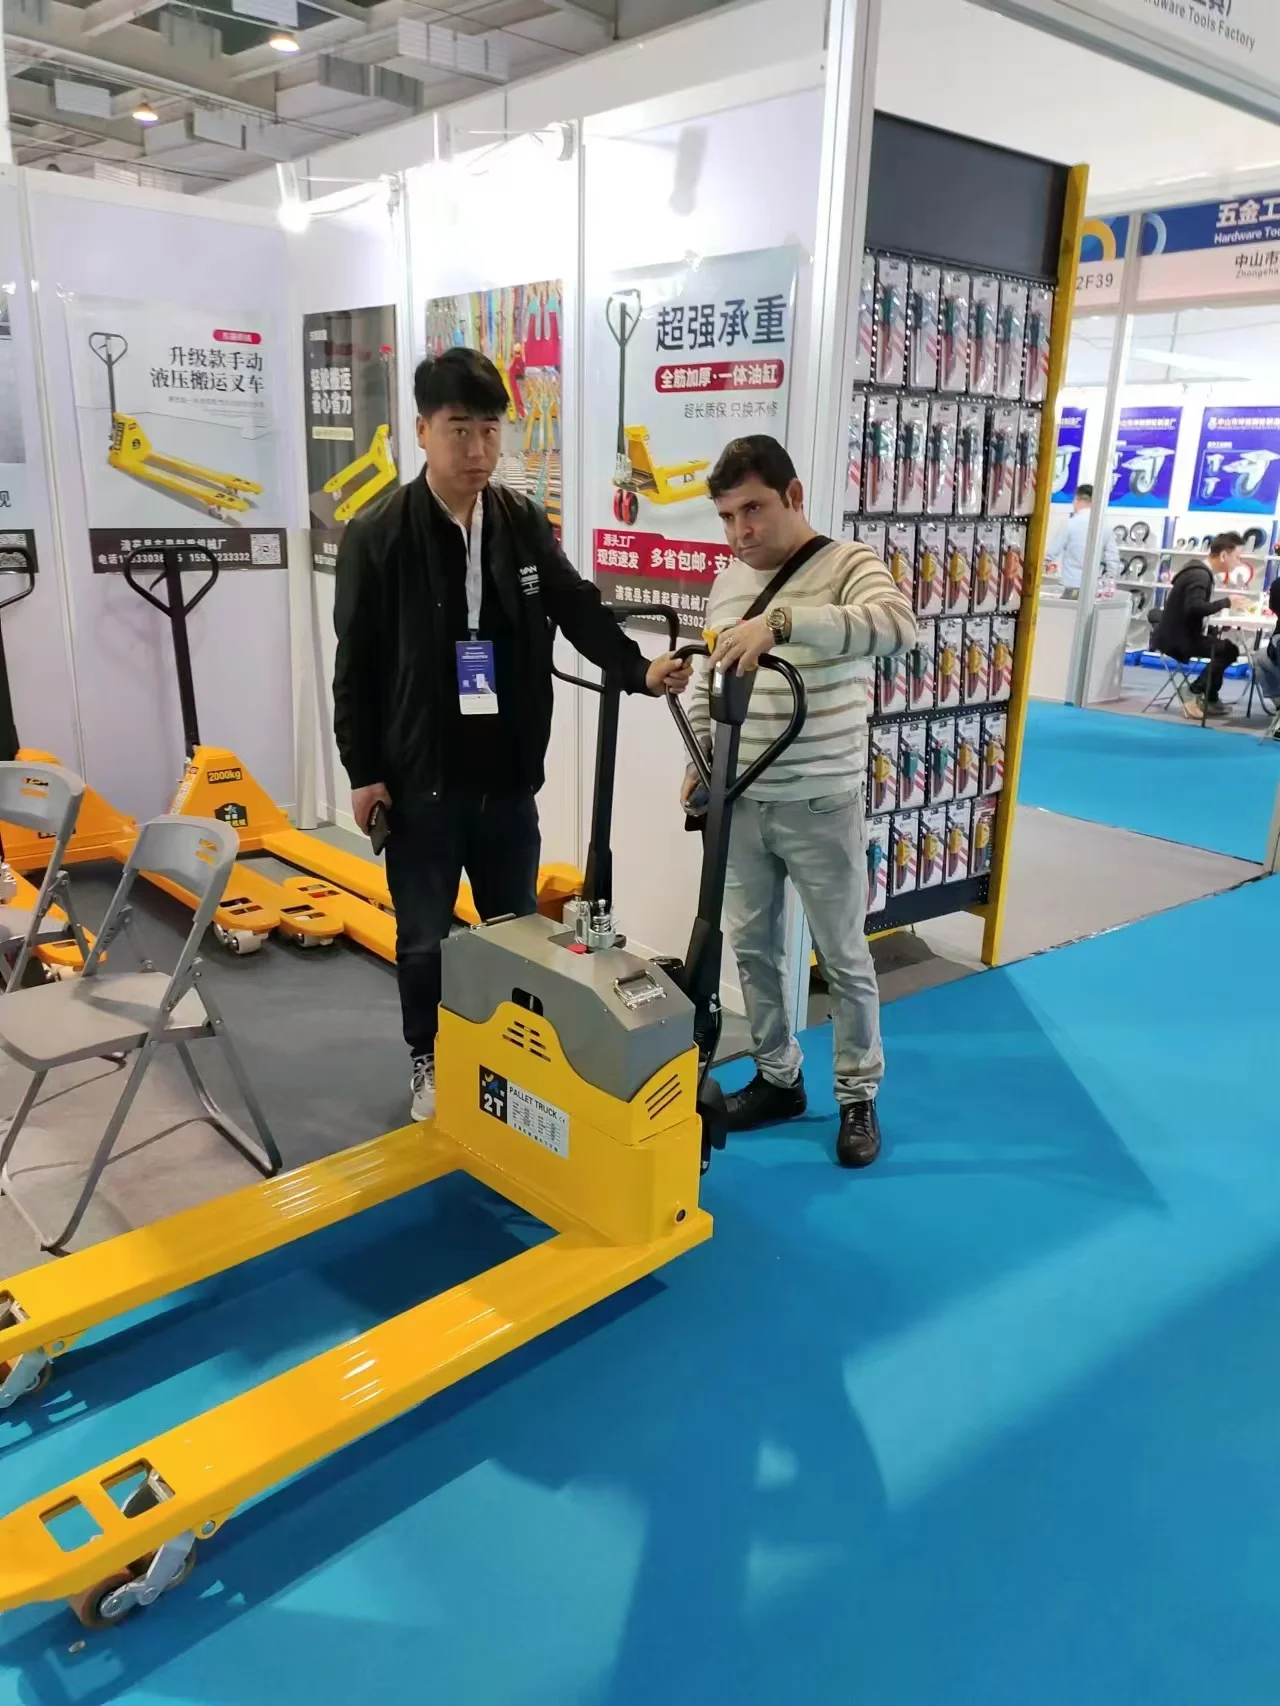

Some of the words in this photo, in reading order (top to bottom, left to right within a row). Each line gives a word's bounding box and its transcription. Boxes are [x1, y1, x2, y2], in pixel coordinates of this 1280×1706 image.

[1189, 5, 1215, 32] Tools
[1218, 19, 1255, 52] Factory
[1214, 229, 1262, 245] Hardware
[656, 294, 787, 352] 超强承重
[168, 346, 263, 371] 升级款手动
[150, 366, 265, 393] 液压搬运叉车
[311, 391, 351, 414] 省心省力
[684, 401, 727, 418] 超长质保
[603, 533, 636, 548] 源头工厂
[597, 549, 640, 569] 现货速发
[208, 769, 241, 782] 2000kg
[484, 1093, 504, 1117] 2T
[509, 1086, 534, 1105] PALLET
[534, 1099, 558, 1120] TRUCK
